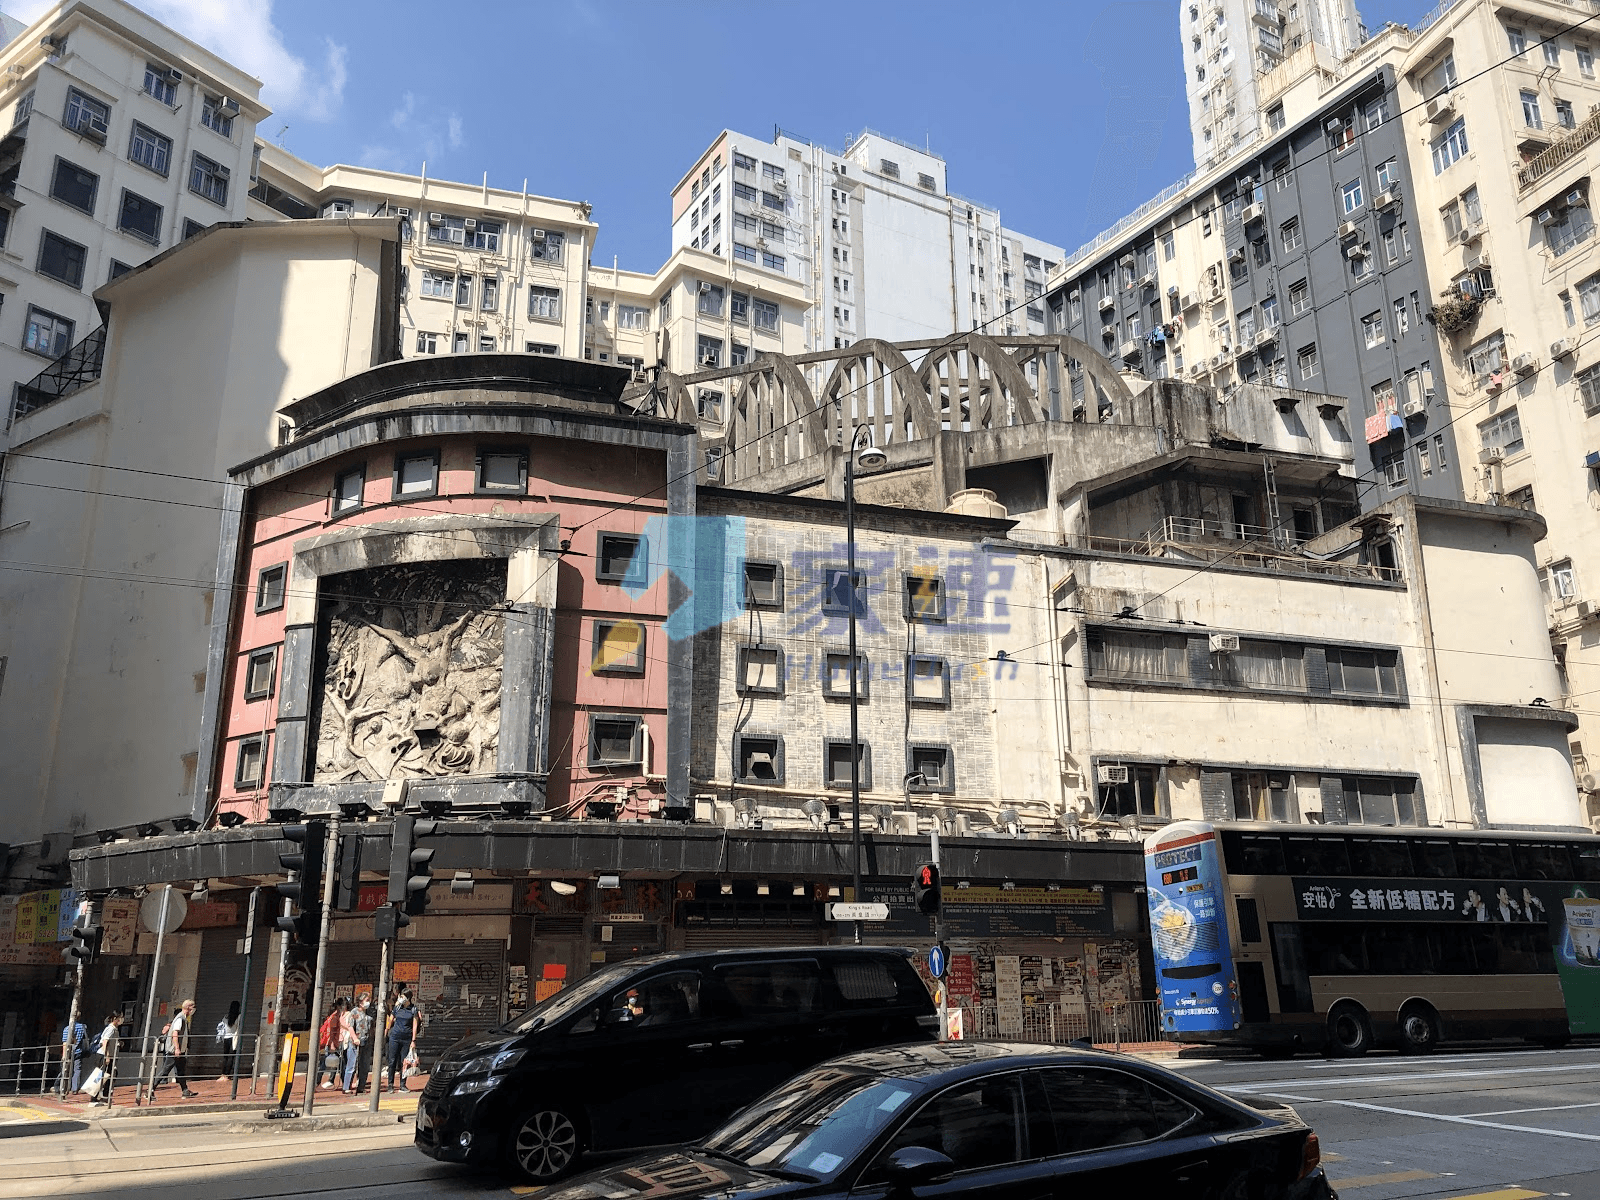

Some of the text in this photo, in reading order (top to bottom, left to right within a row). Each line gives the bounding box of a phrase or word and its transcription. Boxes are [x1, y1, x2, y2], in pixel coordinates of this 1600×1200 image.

[1154, 846, 1198, 868] PROTECT
[1302, 892, 1328, 909] 安怡
[1349, 889, 1455, 911] 全新低糖配方
